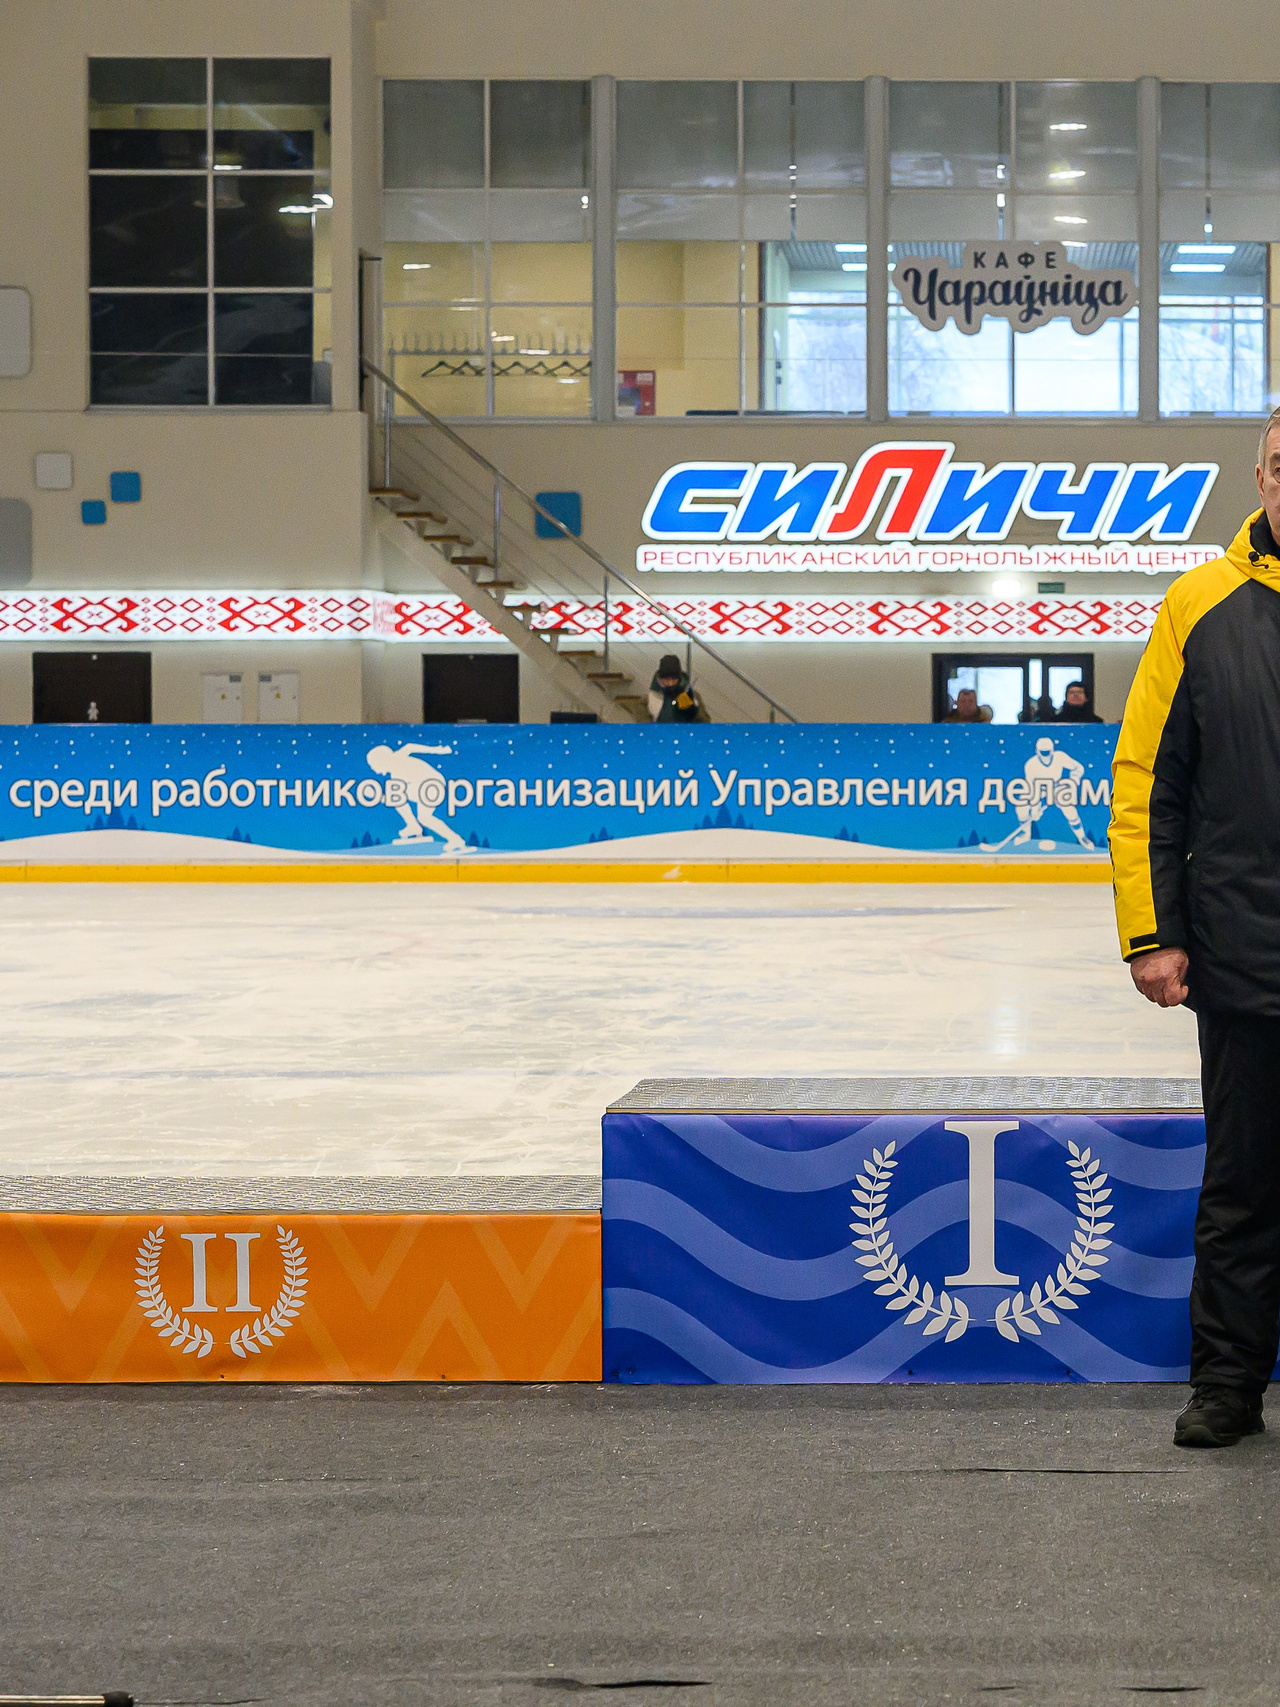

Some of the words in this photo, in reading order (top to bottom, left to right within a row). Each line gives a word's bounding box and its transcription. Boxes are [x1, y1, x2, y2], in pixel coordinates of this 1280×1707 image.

[973, 251, 1057, 269] КАФЕ
[902, 267, 1129, 326] Чараўніца
[643, 547, 911, 566] РЕСПУБЛИКАНСКИЙ
[918, 547, 1129, 566] ГОРНОЛЫЖНЫЙ
[1137, 551, 1219, 569] ЦЕНТР
[8, 777, 138, 817] среди
[151, 768, 407, 817] работников
[418, 769, 698, 815] организаций
[710, 769, 967, 816] Управления
[977, 777, 1111, 814] делам
[943, 1120, 1020, 1287] I
[180, 1232, 261, 1313] II
